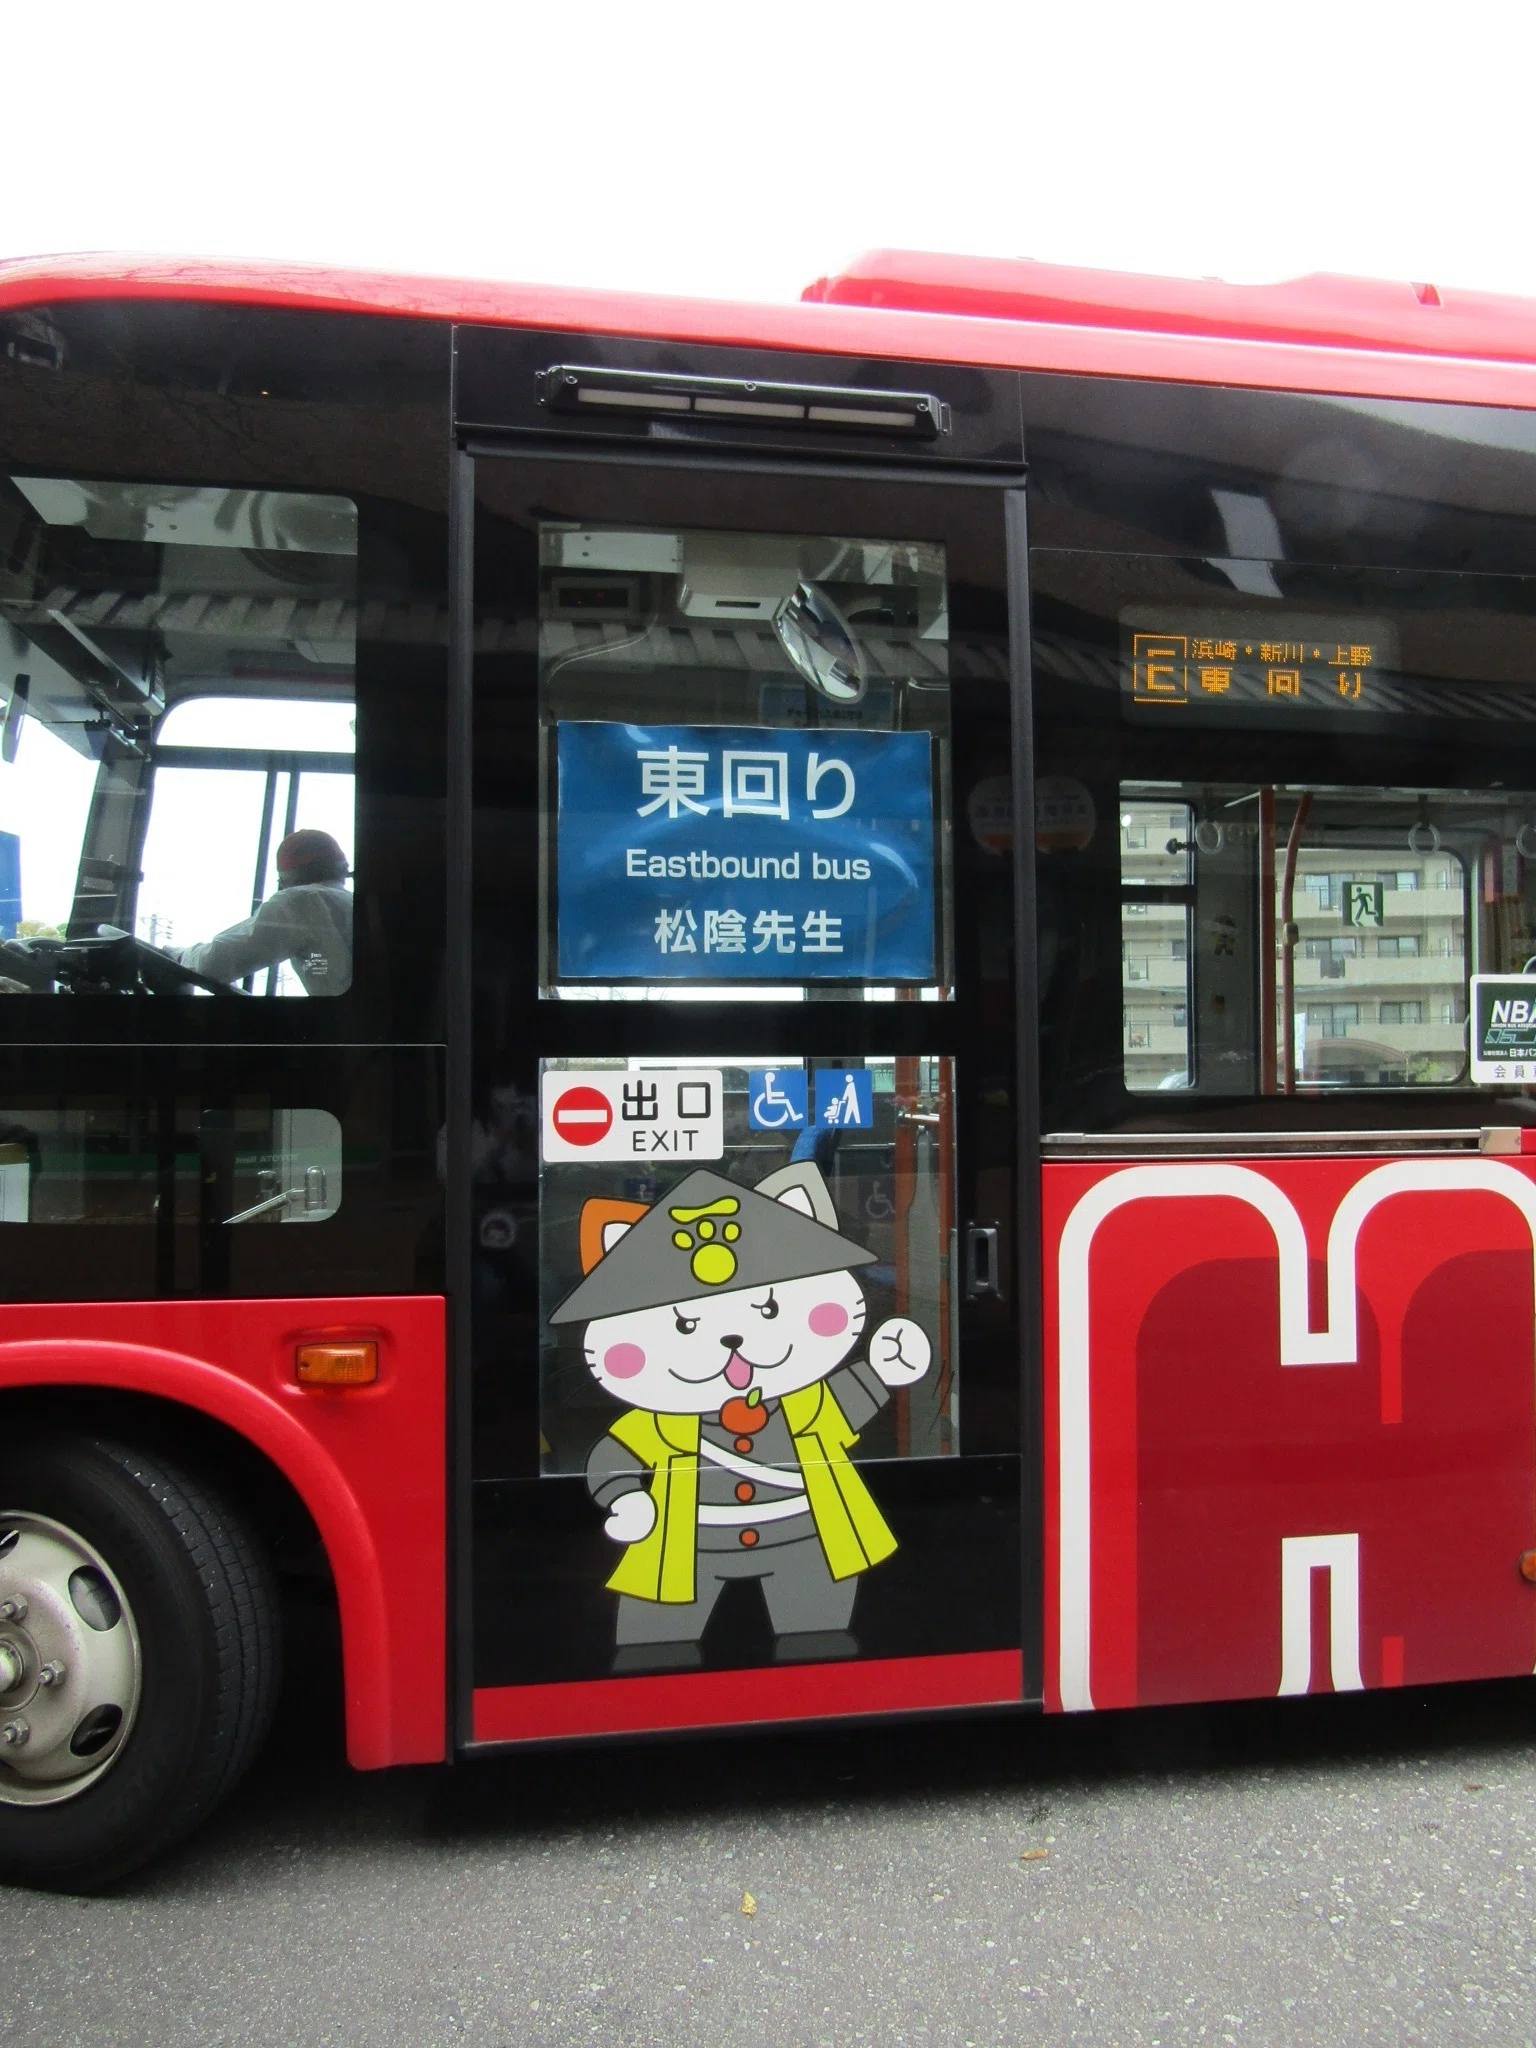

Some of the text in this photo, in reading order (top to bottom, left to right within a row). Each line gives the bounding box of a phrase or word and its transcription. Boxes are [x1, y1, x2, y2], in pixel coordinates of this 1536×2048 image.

[636, 745, 856, 820] 東回り
[626, 848, 872, 880] Eastbound bus
[653, 908, 844, 954] 松陰先生
[622, 1079, 711, 1121] 出口
[632, 1129, 699, 1152] EXIT
